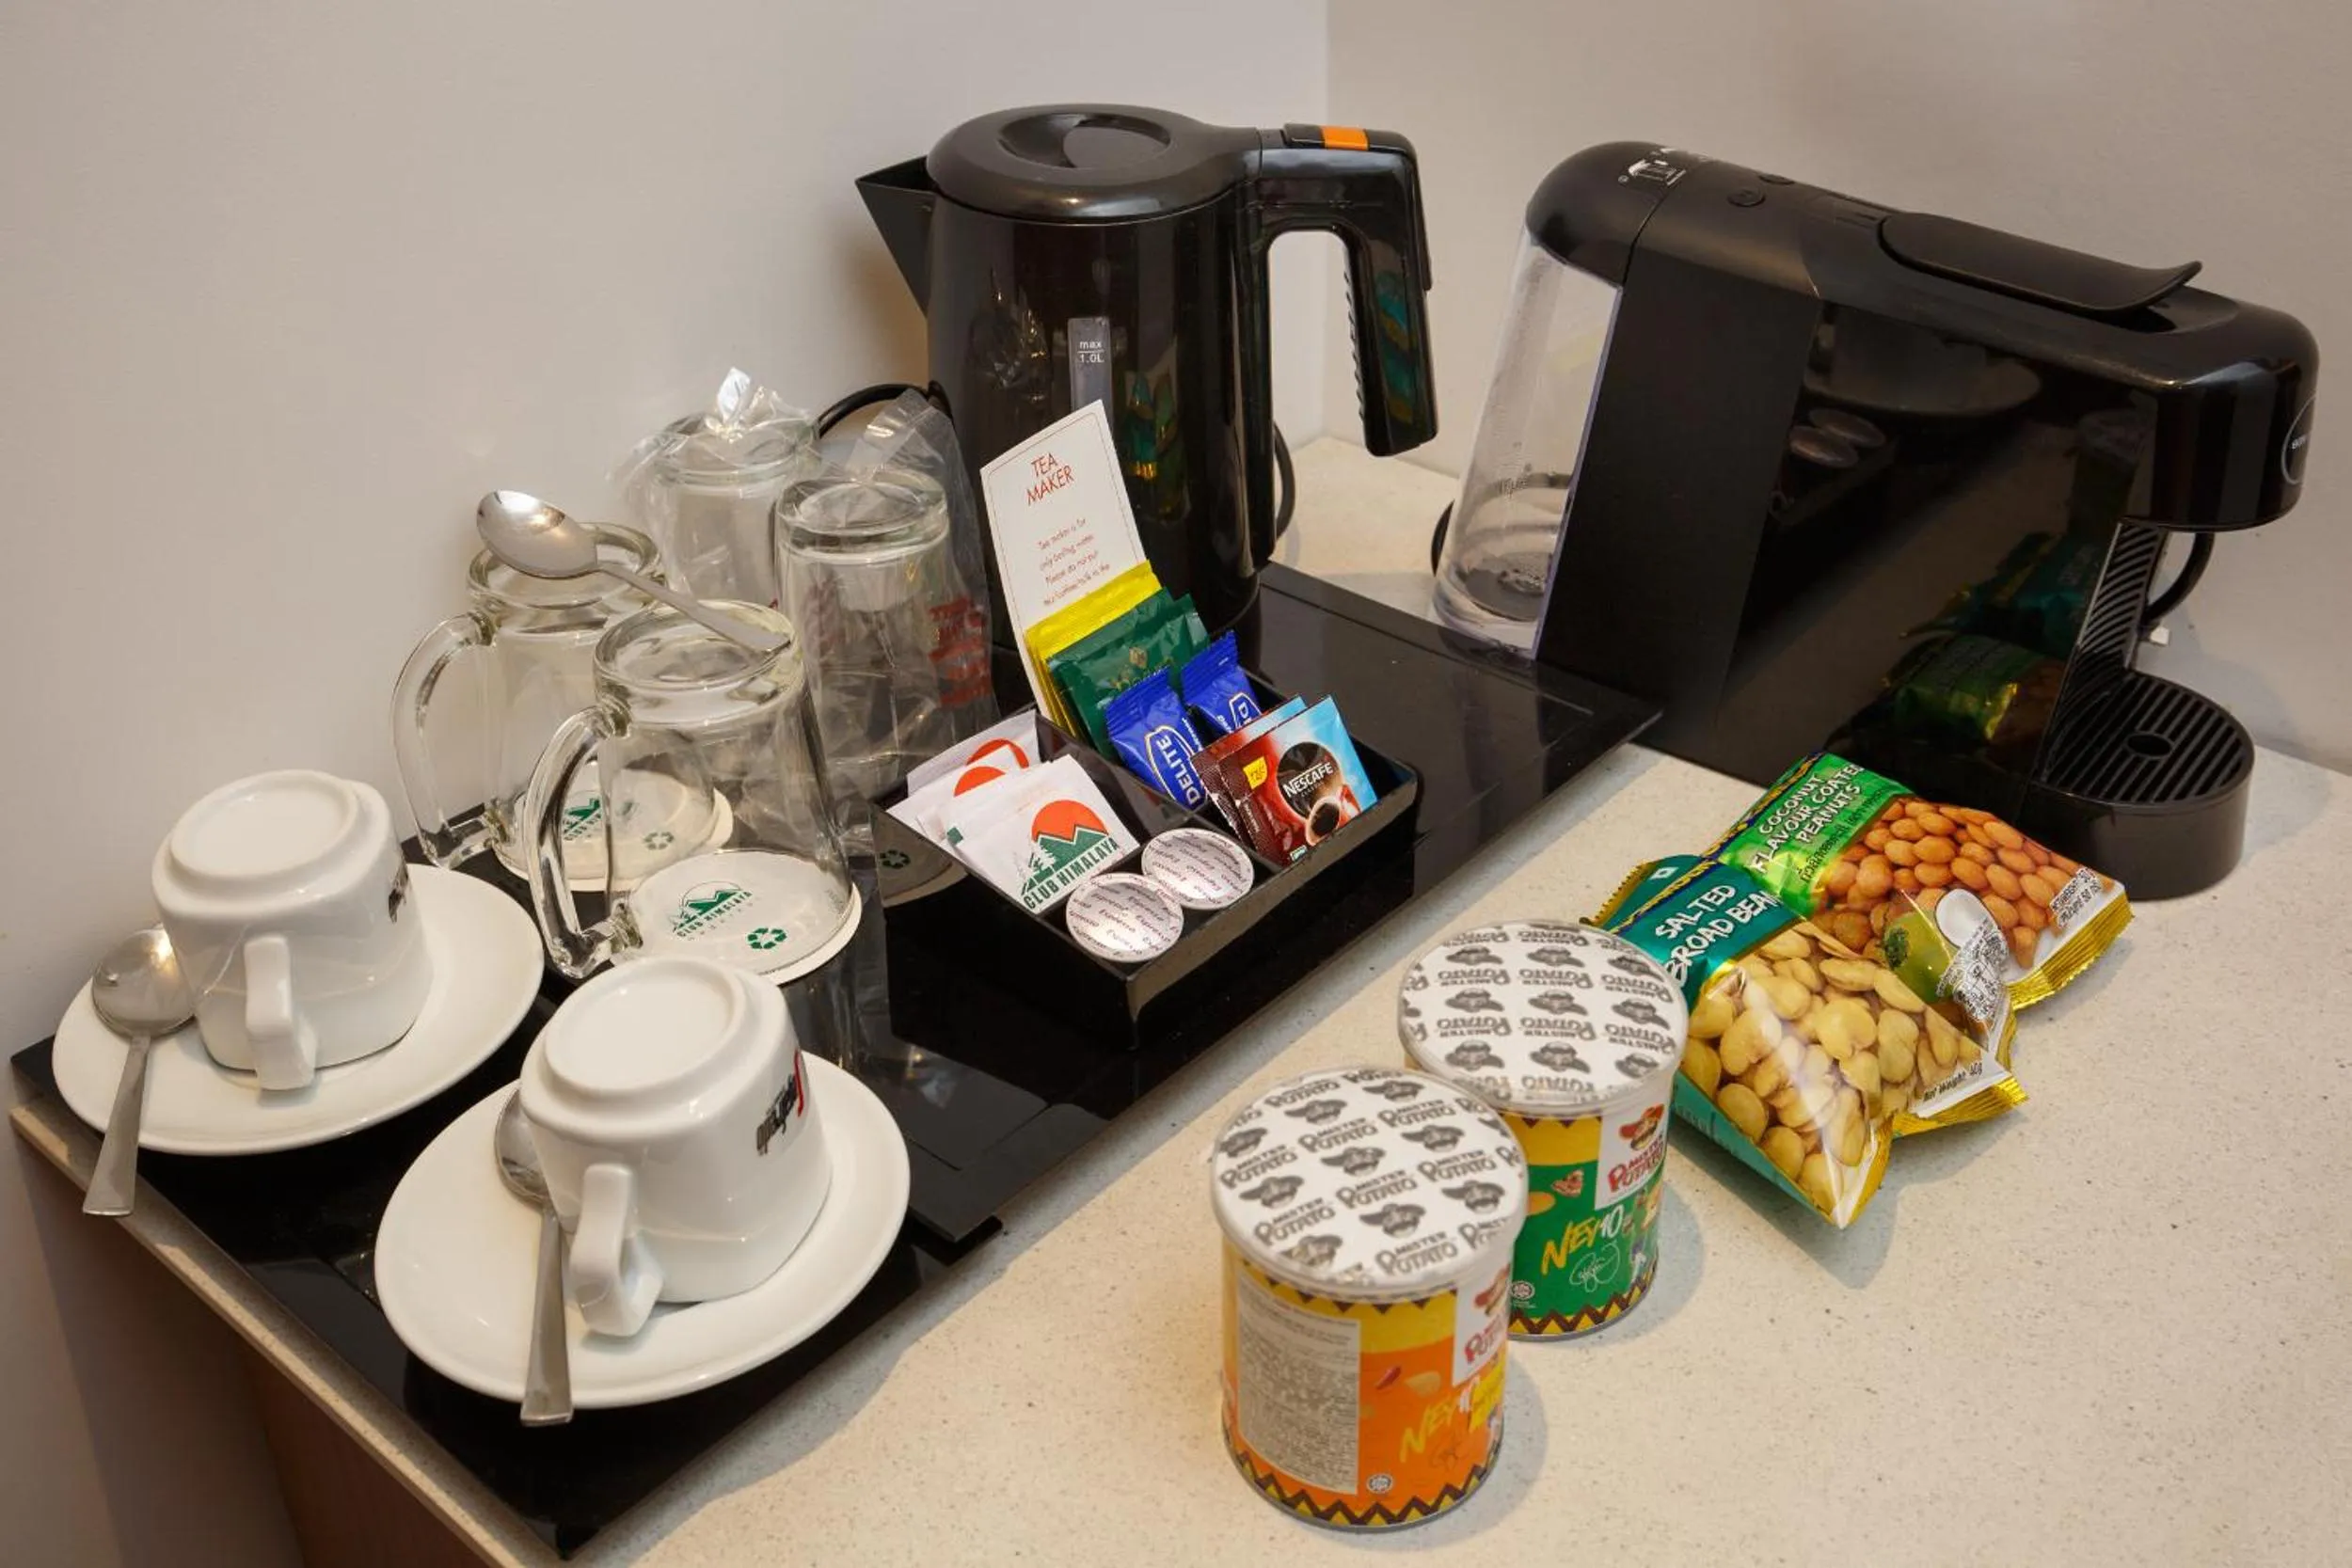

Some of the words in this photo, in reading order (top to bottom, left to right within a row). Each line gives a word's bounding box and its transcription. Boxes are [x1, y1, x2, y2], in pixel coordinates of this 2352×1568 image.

[1079, 341, 1103, 350] max
[1079, 353, 1105, 364] 1.0L
[1025, 466, 1075, 506] MAKER
[1031, 452, 1058, 478] TEA
[1155, 735, 1201, 806] DELITE
[1758, 773, 1824, 834] COCONUT
[1795, 784, 1862, 844] PEANUTS
[1751, 804, 1821, 875] FLAVOUR
[1023, 879, 1060, 910] CLUB
[1056, 836, 1120, 887] HIMALAYA
[1655, 884, 1737, 940] SALTED
